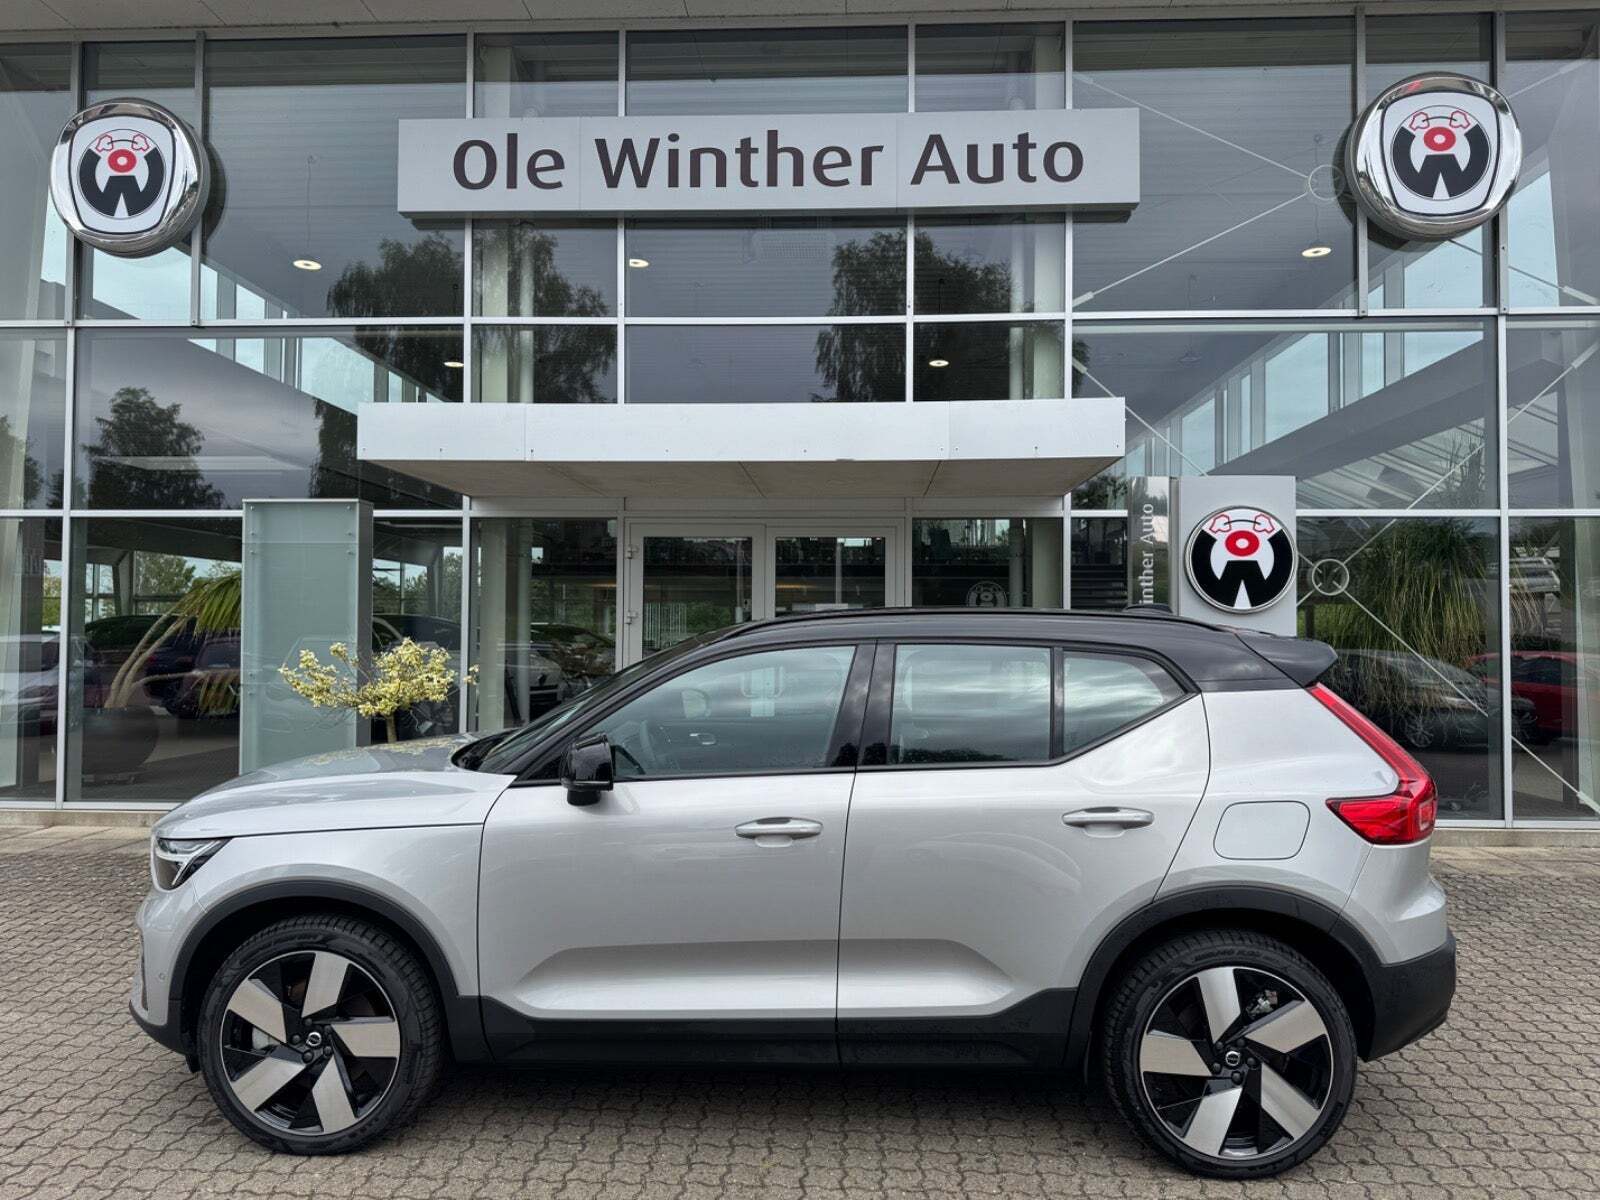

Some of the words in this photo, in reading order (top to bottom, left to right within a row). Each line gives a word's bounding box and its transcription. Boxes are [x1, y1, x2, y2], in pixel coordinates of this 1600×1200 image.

[453, 132, 565, 191] Ole
[595, 129, 885, 189] Winther
[910, 131, 1084, 186] Auto
[1140, 503, 1154, 545] Auto
[1138, 550, 1154, 604] inther
